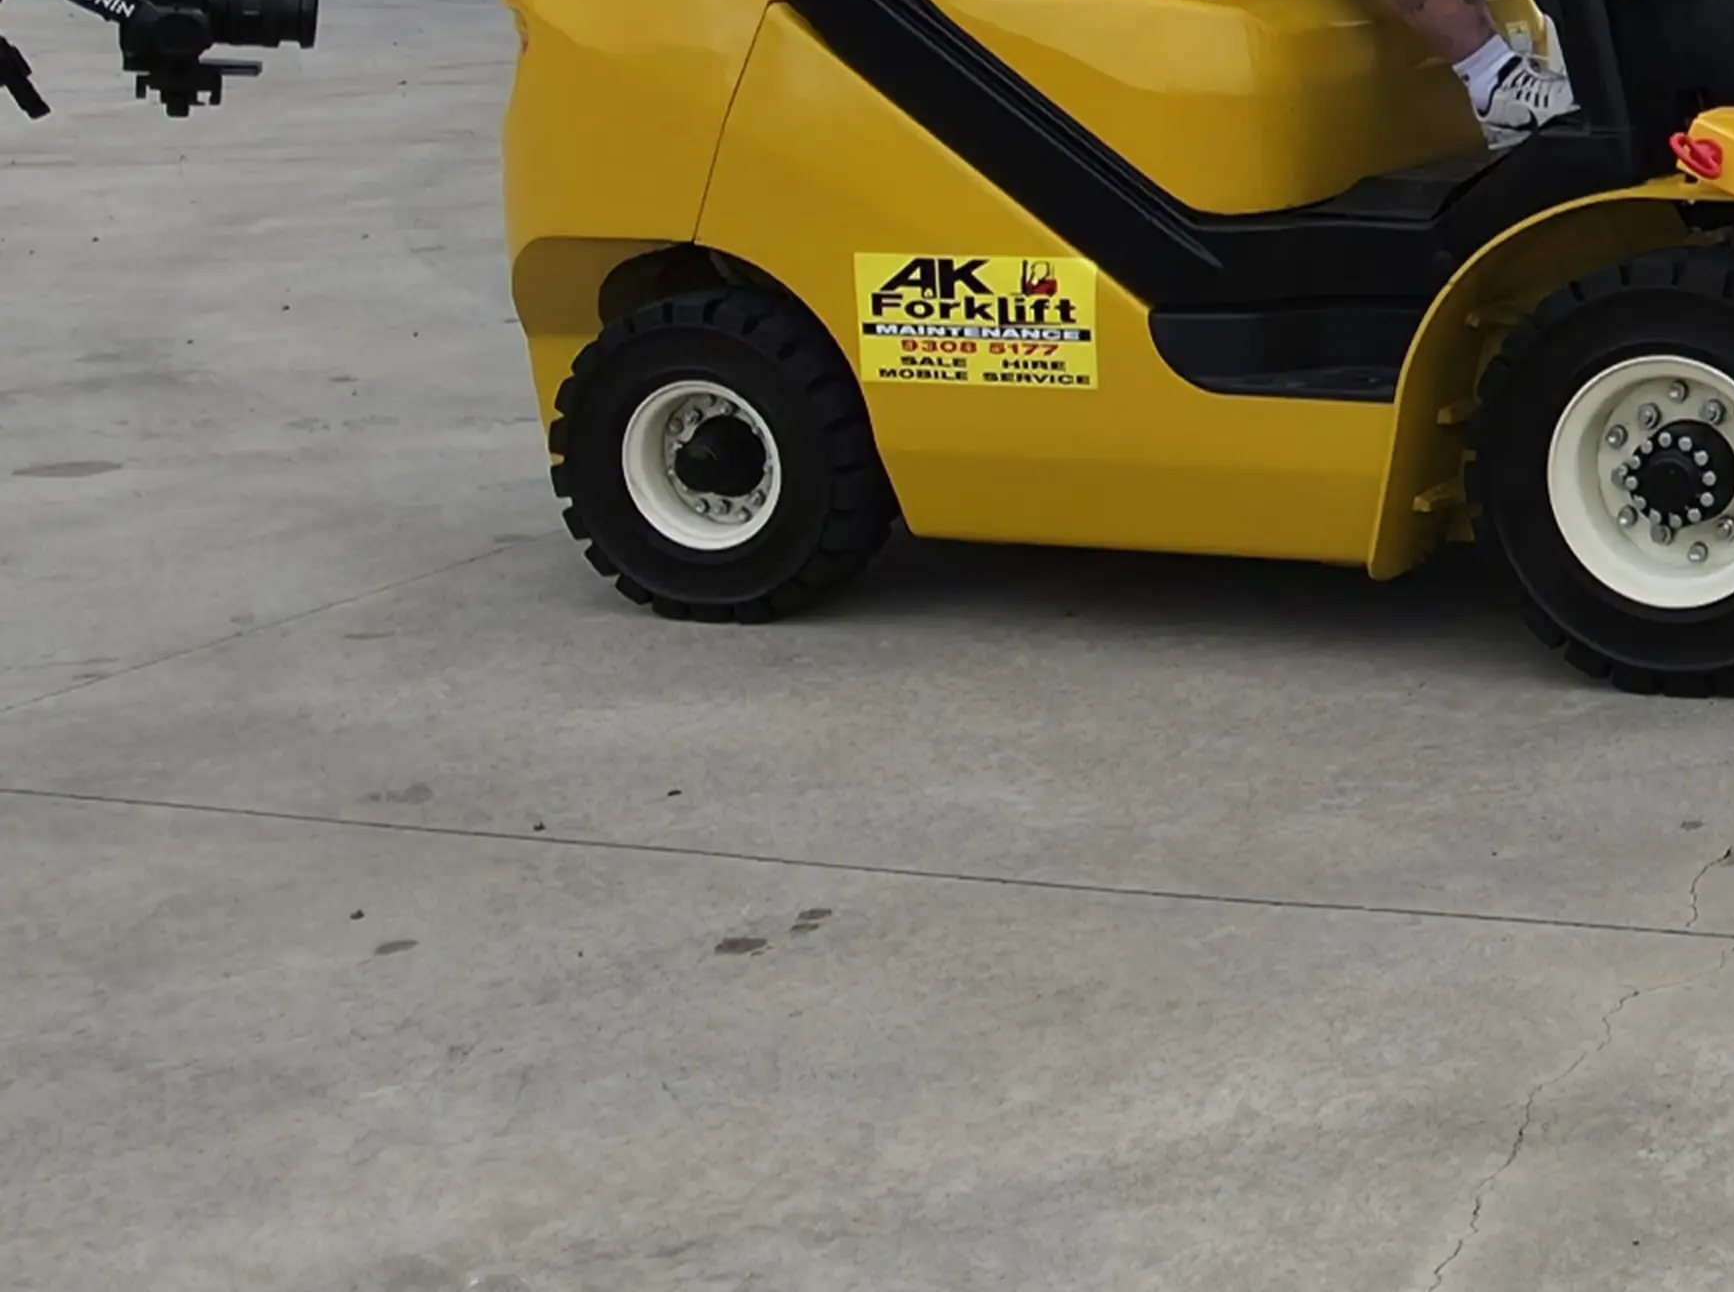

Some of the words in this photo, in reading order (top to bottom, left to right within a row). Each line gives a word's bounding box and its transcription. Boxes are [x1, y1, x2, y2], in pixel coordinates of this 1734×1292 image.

[880, 258, 993, 299] AK
[871, 293, 1076, 325] Forklift
[876, 325, 1080, 339] MAINTENANCE
[902, 340, 977, 354] 9308
[989, 342, 1059, 355] 5177
[901, 356, 967, 368] SALE
[1002, 359, 1065, 371] HIRE
[879, 368, 968, 380] MOBILE
[983, 372, 1090, 385] SERVICE
